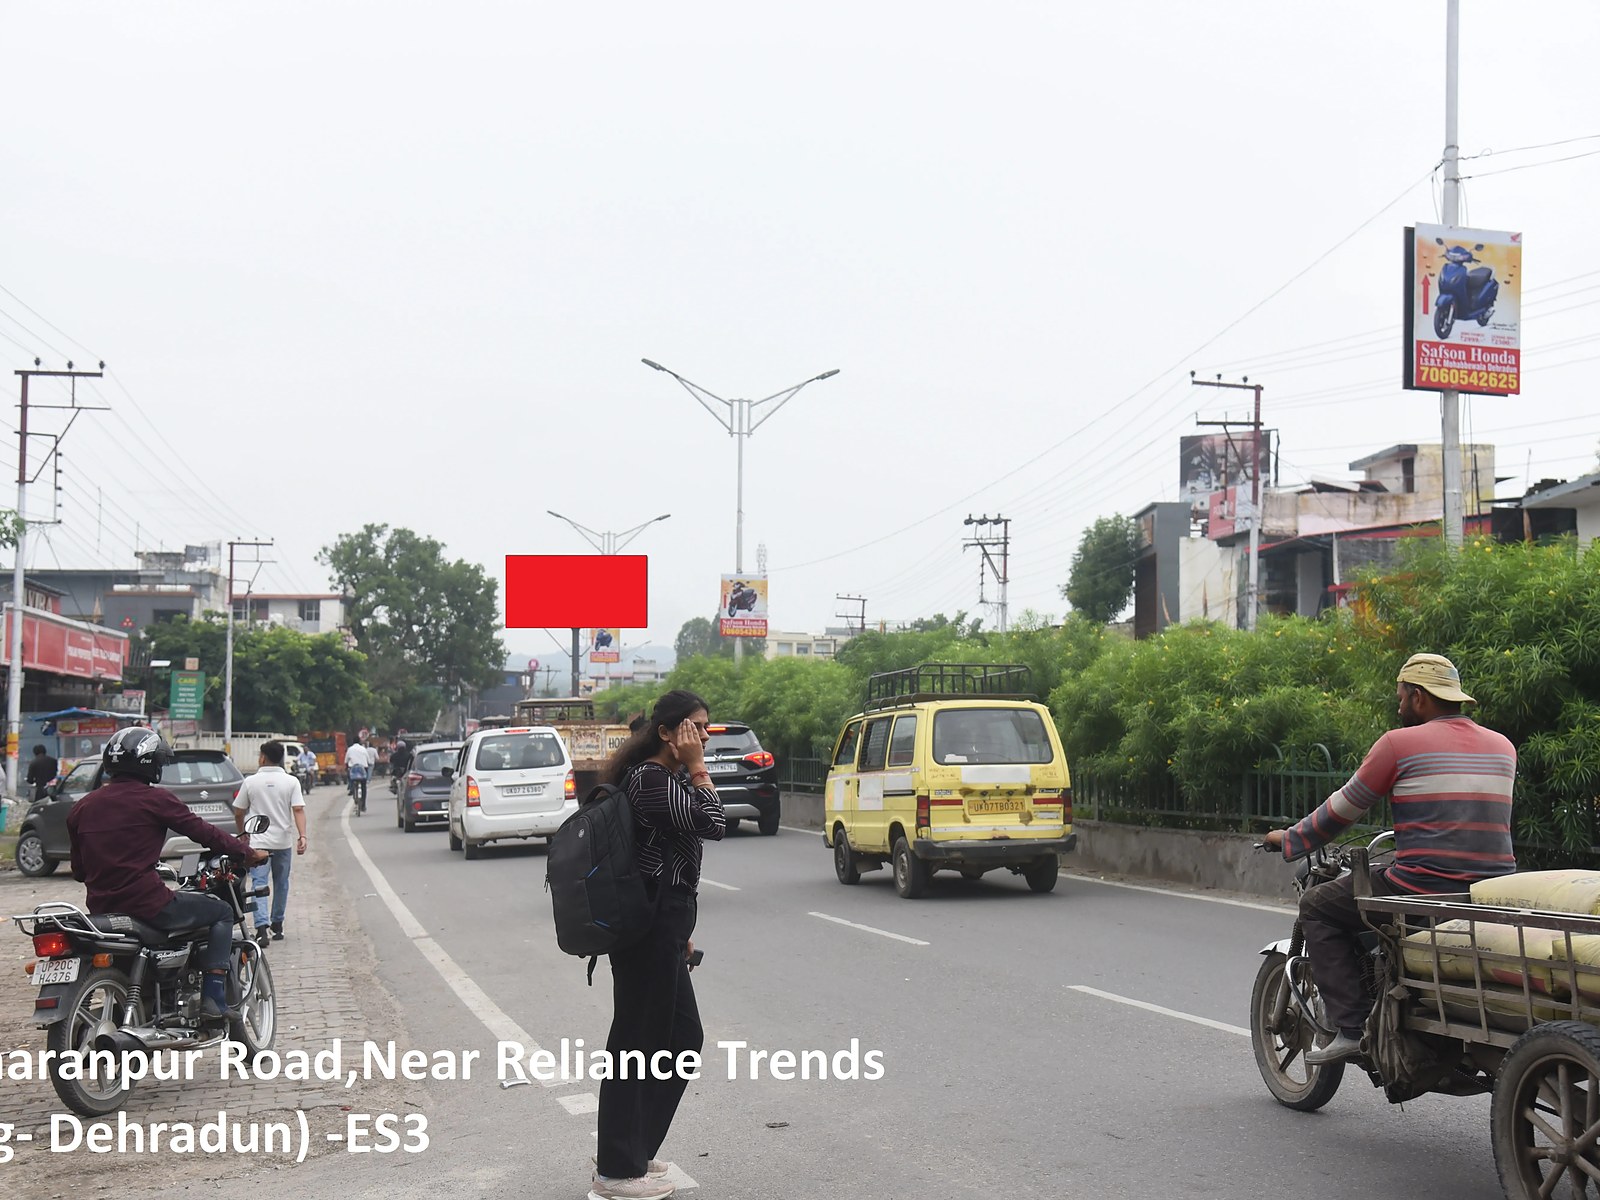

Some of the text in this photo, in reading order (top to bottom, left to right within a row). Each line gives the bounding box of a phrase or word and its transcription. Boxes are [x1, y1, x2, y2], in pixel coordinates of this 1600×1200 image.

[1421, 343, 1516, 365] Safson Honda
[1419, 367, 1518, 389] 7060542625
[100, 697, 140, 708] VIRA
[973, 802, 1025, 813] UK07TB0321
[41, 960, 73, 973] UP20C
[38, 972, 71, 985] H4376
